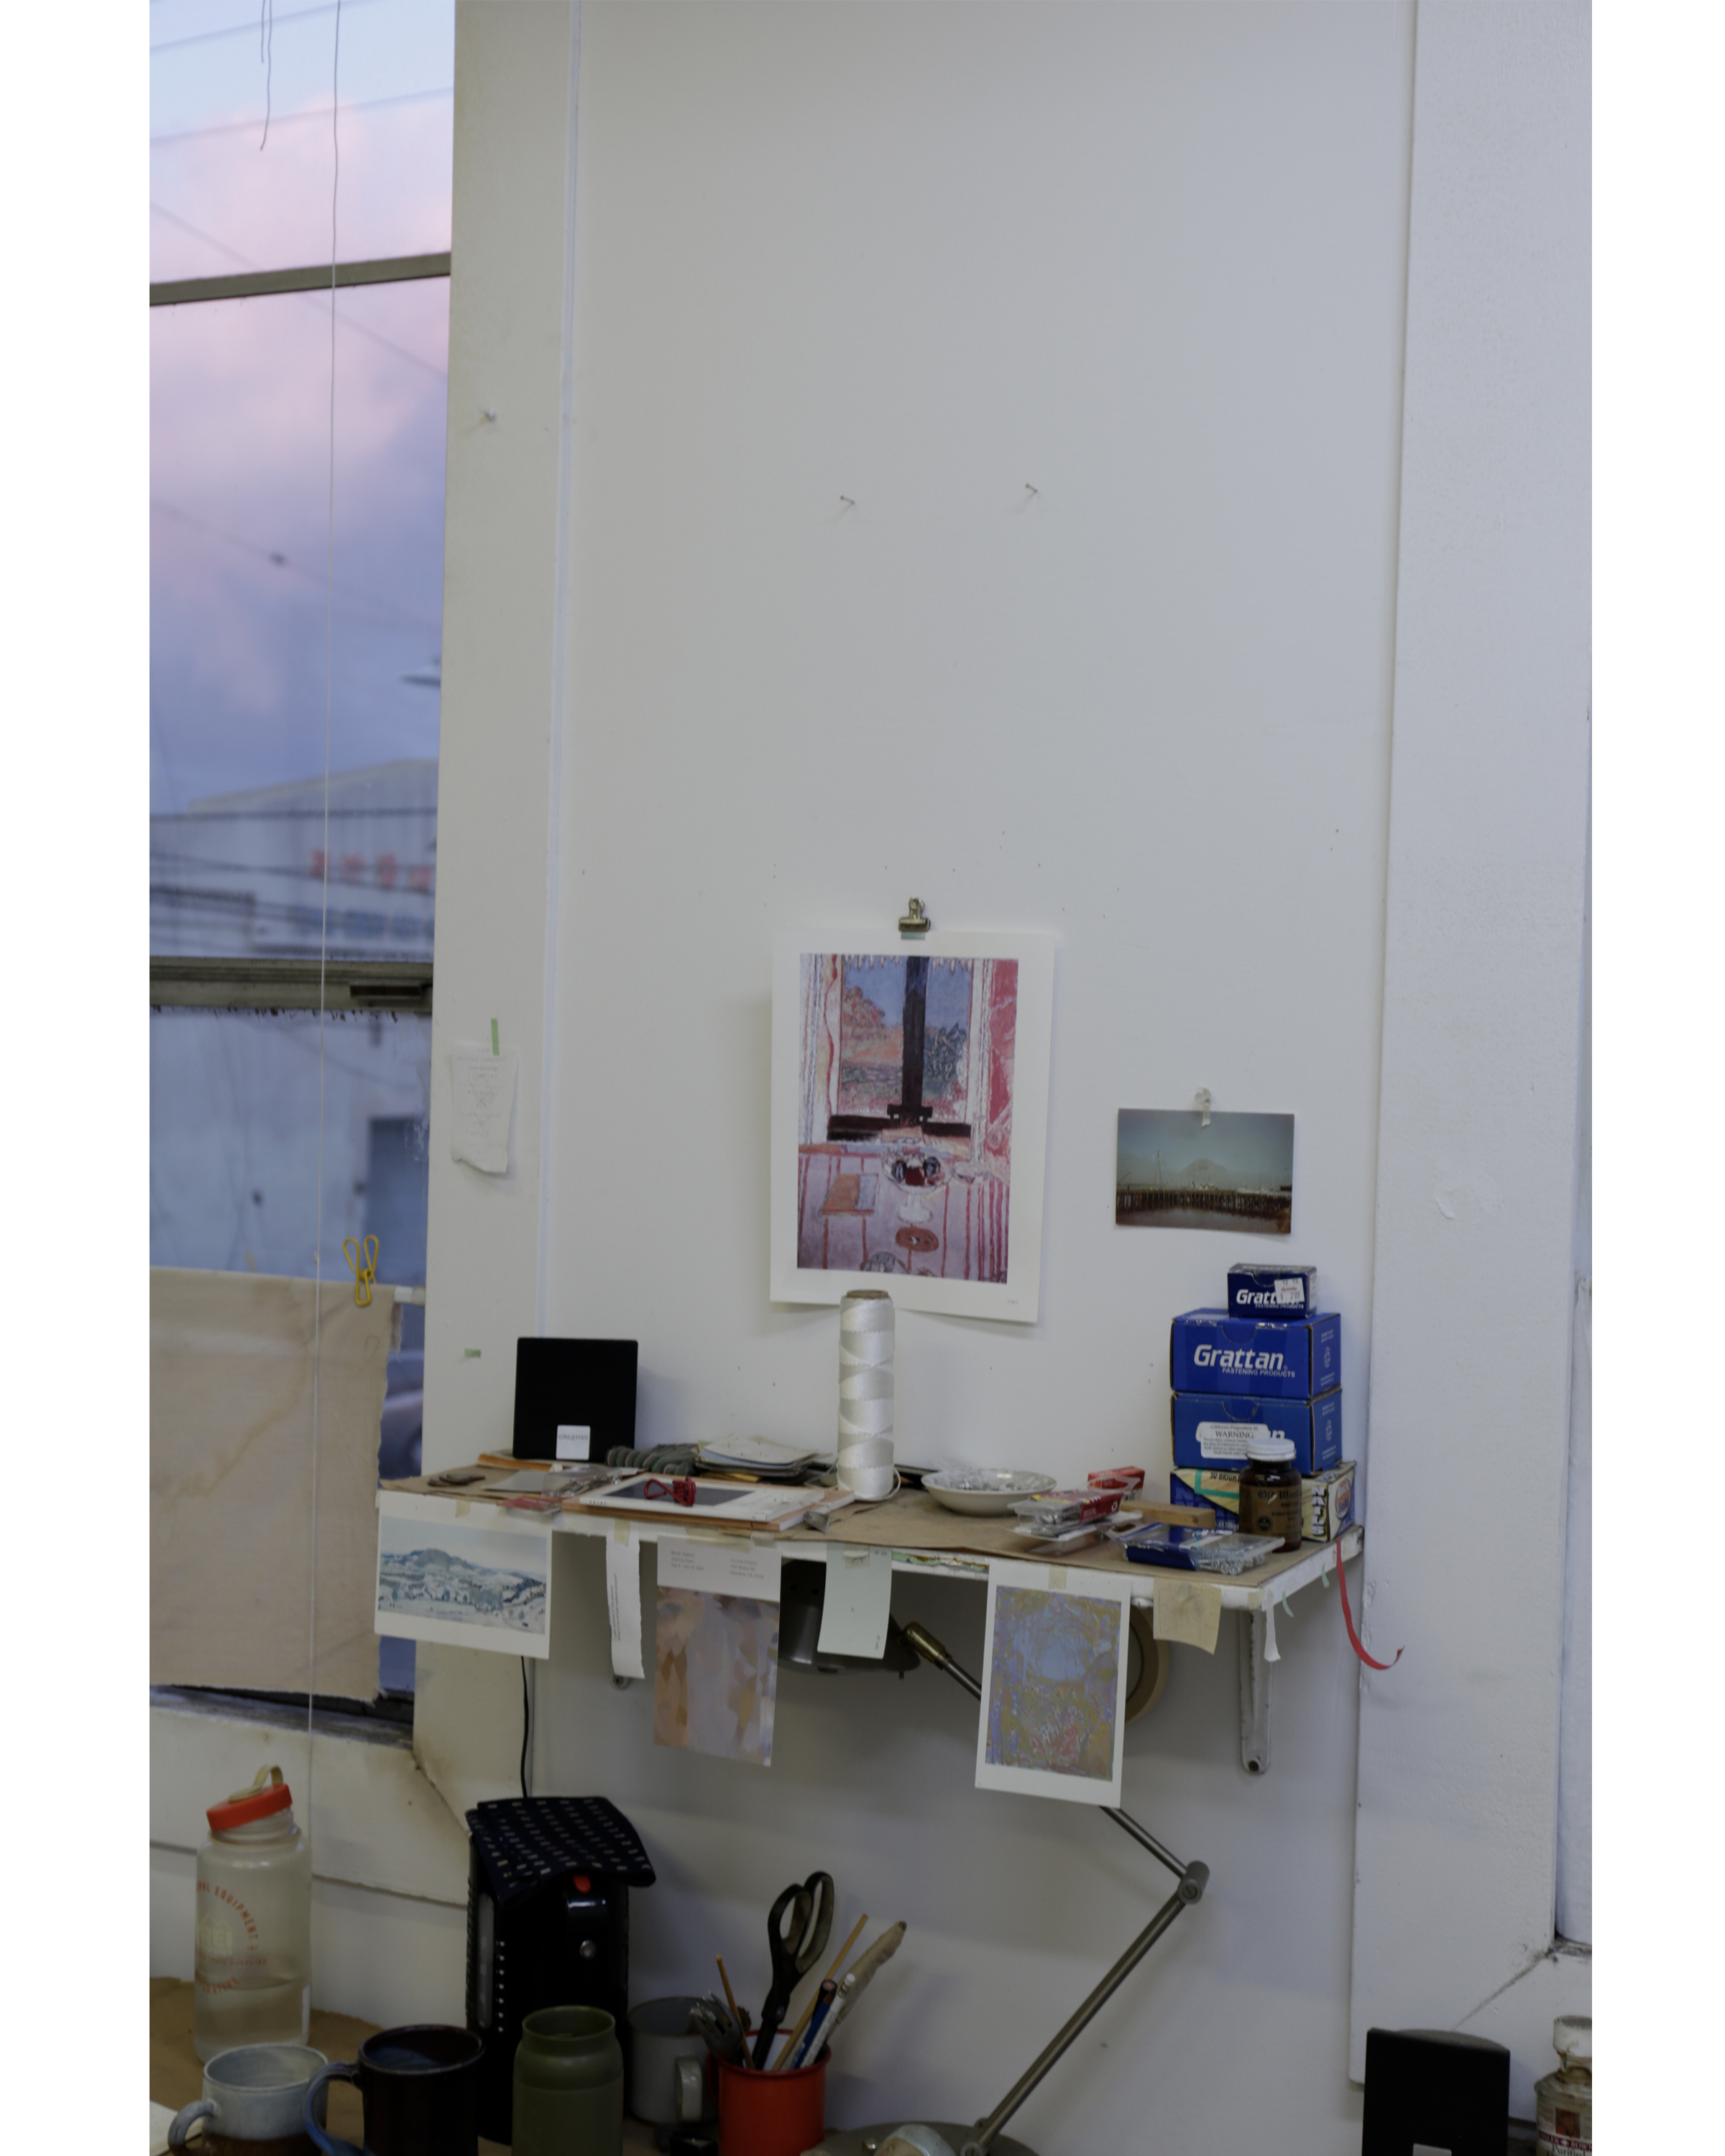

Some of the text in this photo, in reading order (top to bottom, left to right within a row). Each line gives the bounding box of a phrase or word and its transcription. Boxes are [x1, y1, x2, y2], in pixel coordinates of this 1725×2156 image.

[1236, 1289, 1294, 1304] Gratt
[1193, 1344, 1284, 1370] Grattan
[1222, 1368, 1295, 1378] FASTENING PRODUCTS
[1215, 1430, 1254, 1439] WARNING
[1310, 1486, 1326, 1537] NAILS
[215, 1885, 259, 1940] EQUIPMENT
